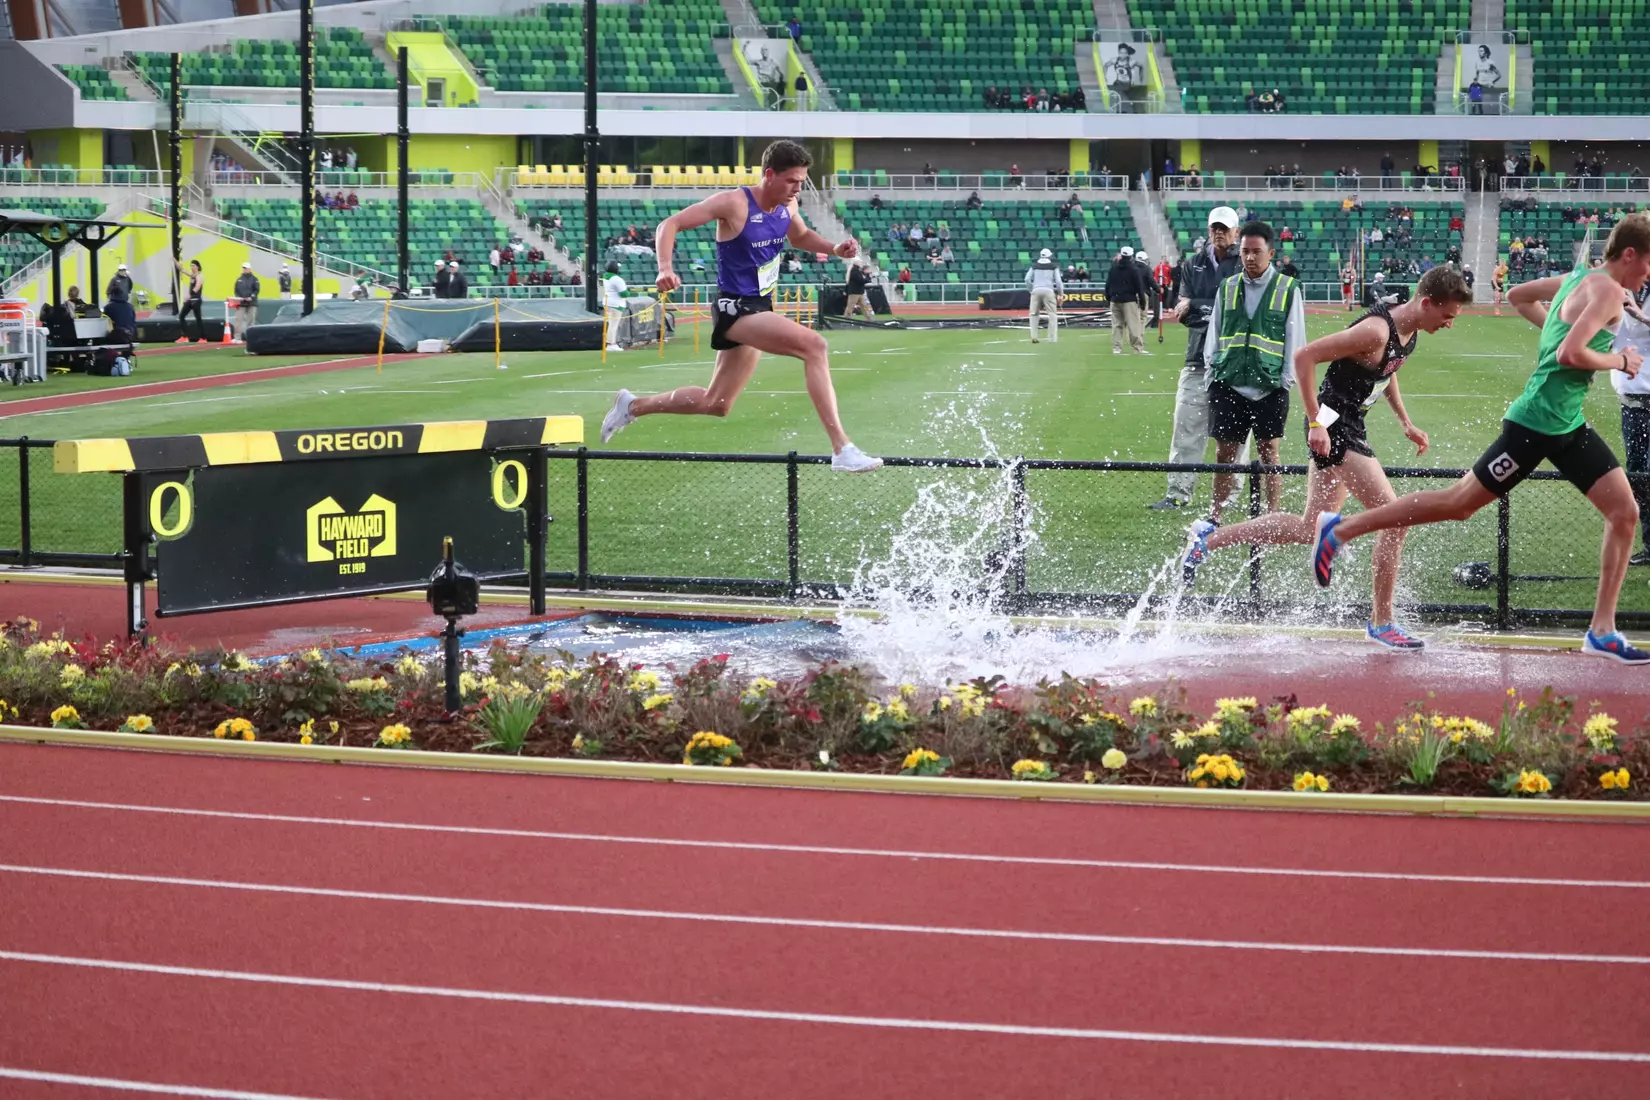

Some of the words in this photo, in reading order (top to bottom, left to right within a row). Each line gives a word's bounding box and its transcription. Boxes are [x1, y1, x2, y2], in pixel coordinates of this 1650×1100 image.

[1056, 293, 1108, 302] OREG
[297, 430, 404, 454] OREGON
[1492, 457, 1514, 477] 8
[320, 513, 383, 541] HAYWARD
[335, 538, 369, 559] FIELD
[339, 563, 352, 575] EST.
[351, 561, 366, 574] 1919
